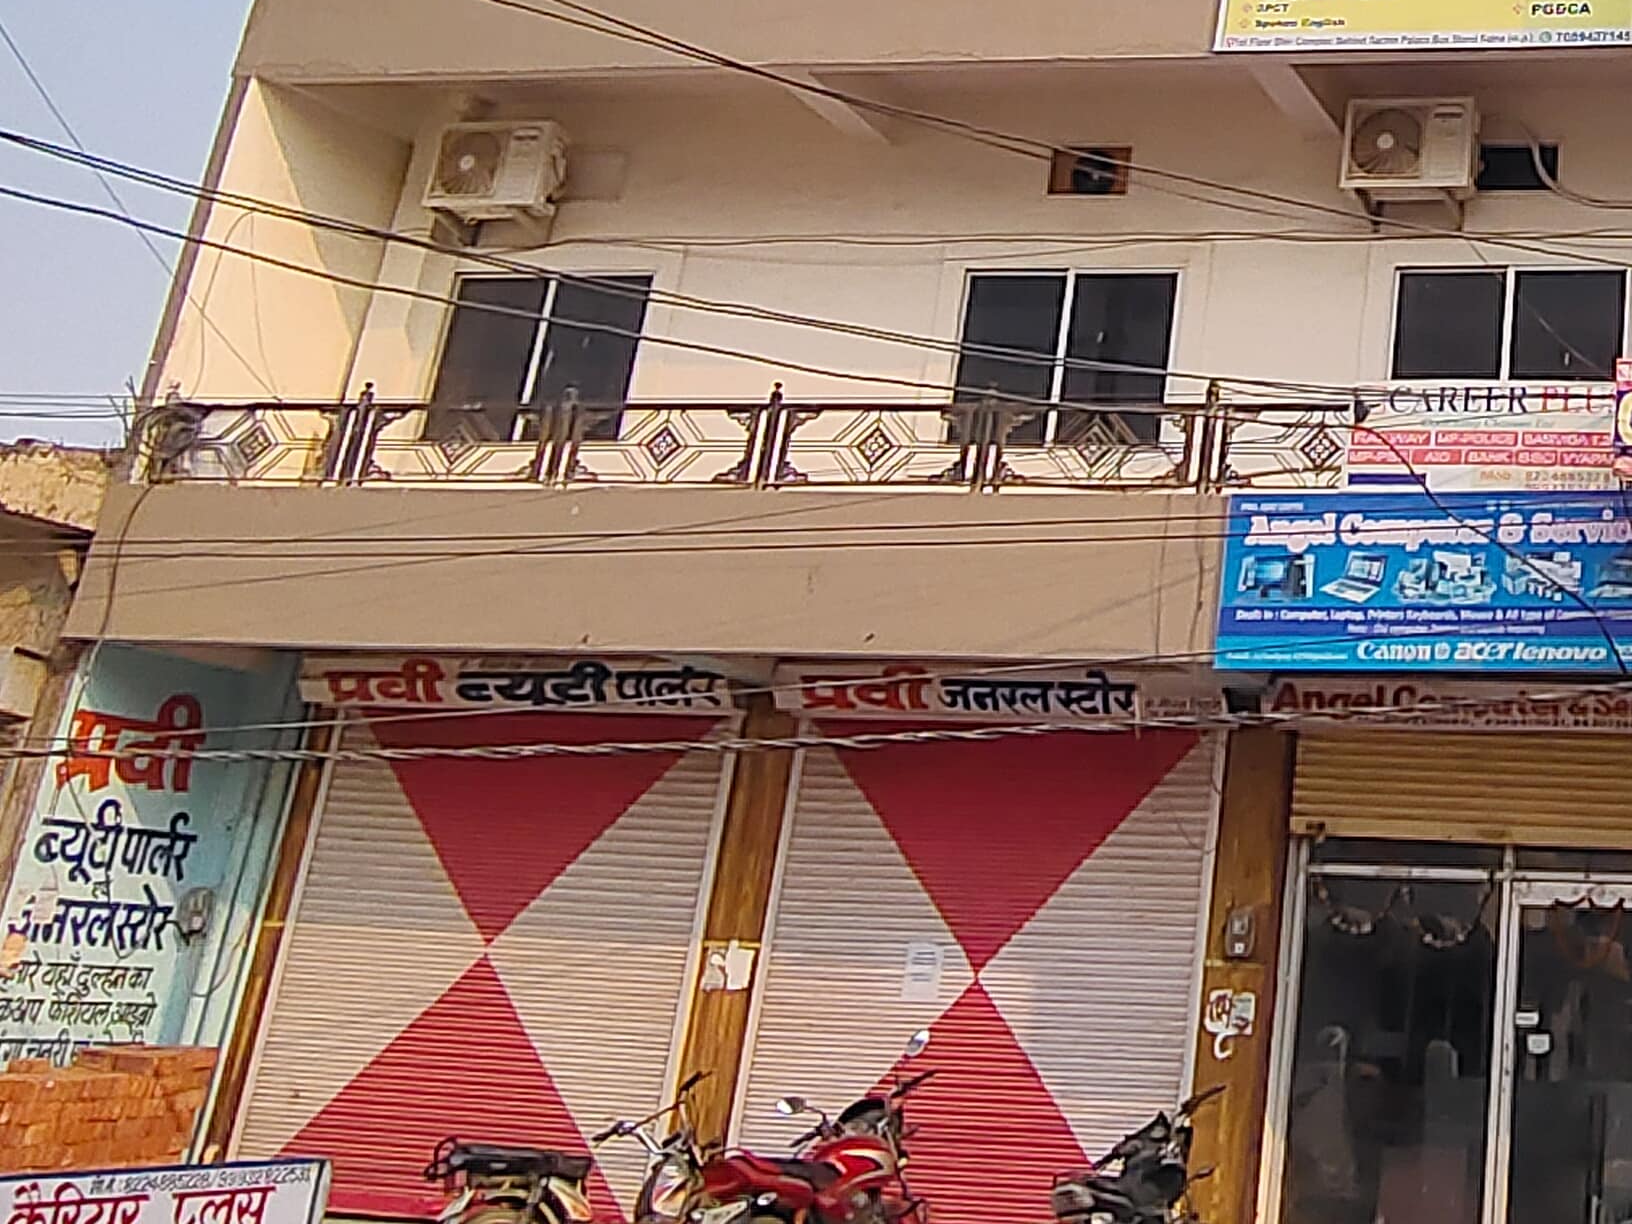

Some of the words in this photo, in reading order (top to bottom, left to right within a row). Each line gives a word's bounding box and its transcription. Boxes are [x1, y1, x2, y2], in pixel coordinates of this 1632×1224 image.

[1390, 386, 1529, 414] CAREER
[1244, 513, 1337, 553] Angel
[1338, 512, 1494, 552] Computer
[1357, 642, 1431, 661] Canon
[1454, 642, 1514, 660] acer
[1513, 643, 1607, 660] lenovo
[1054, 669, 1136, 716] स्टोर
[1271, 682, 1384, 720] Angel
[33, 798, 124, 882] ब्यूटी
[121, 812, 198, 881] पार्लर
[117, 884, 175, 951] स्टोर
[129, 967, 154, 990] का
